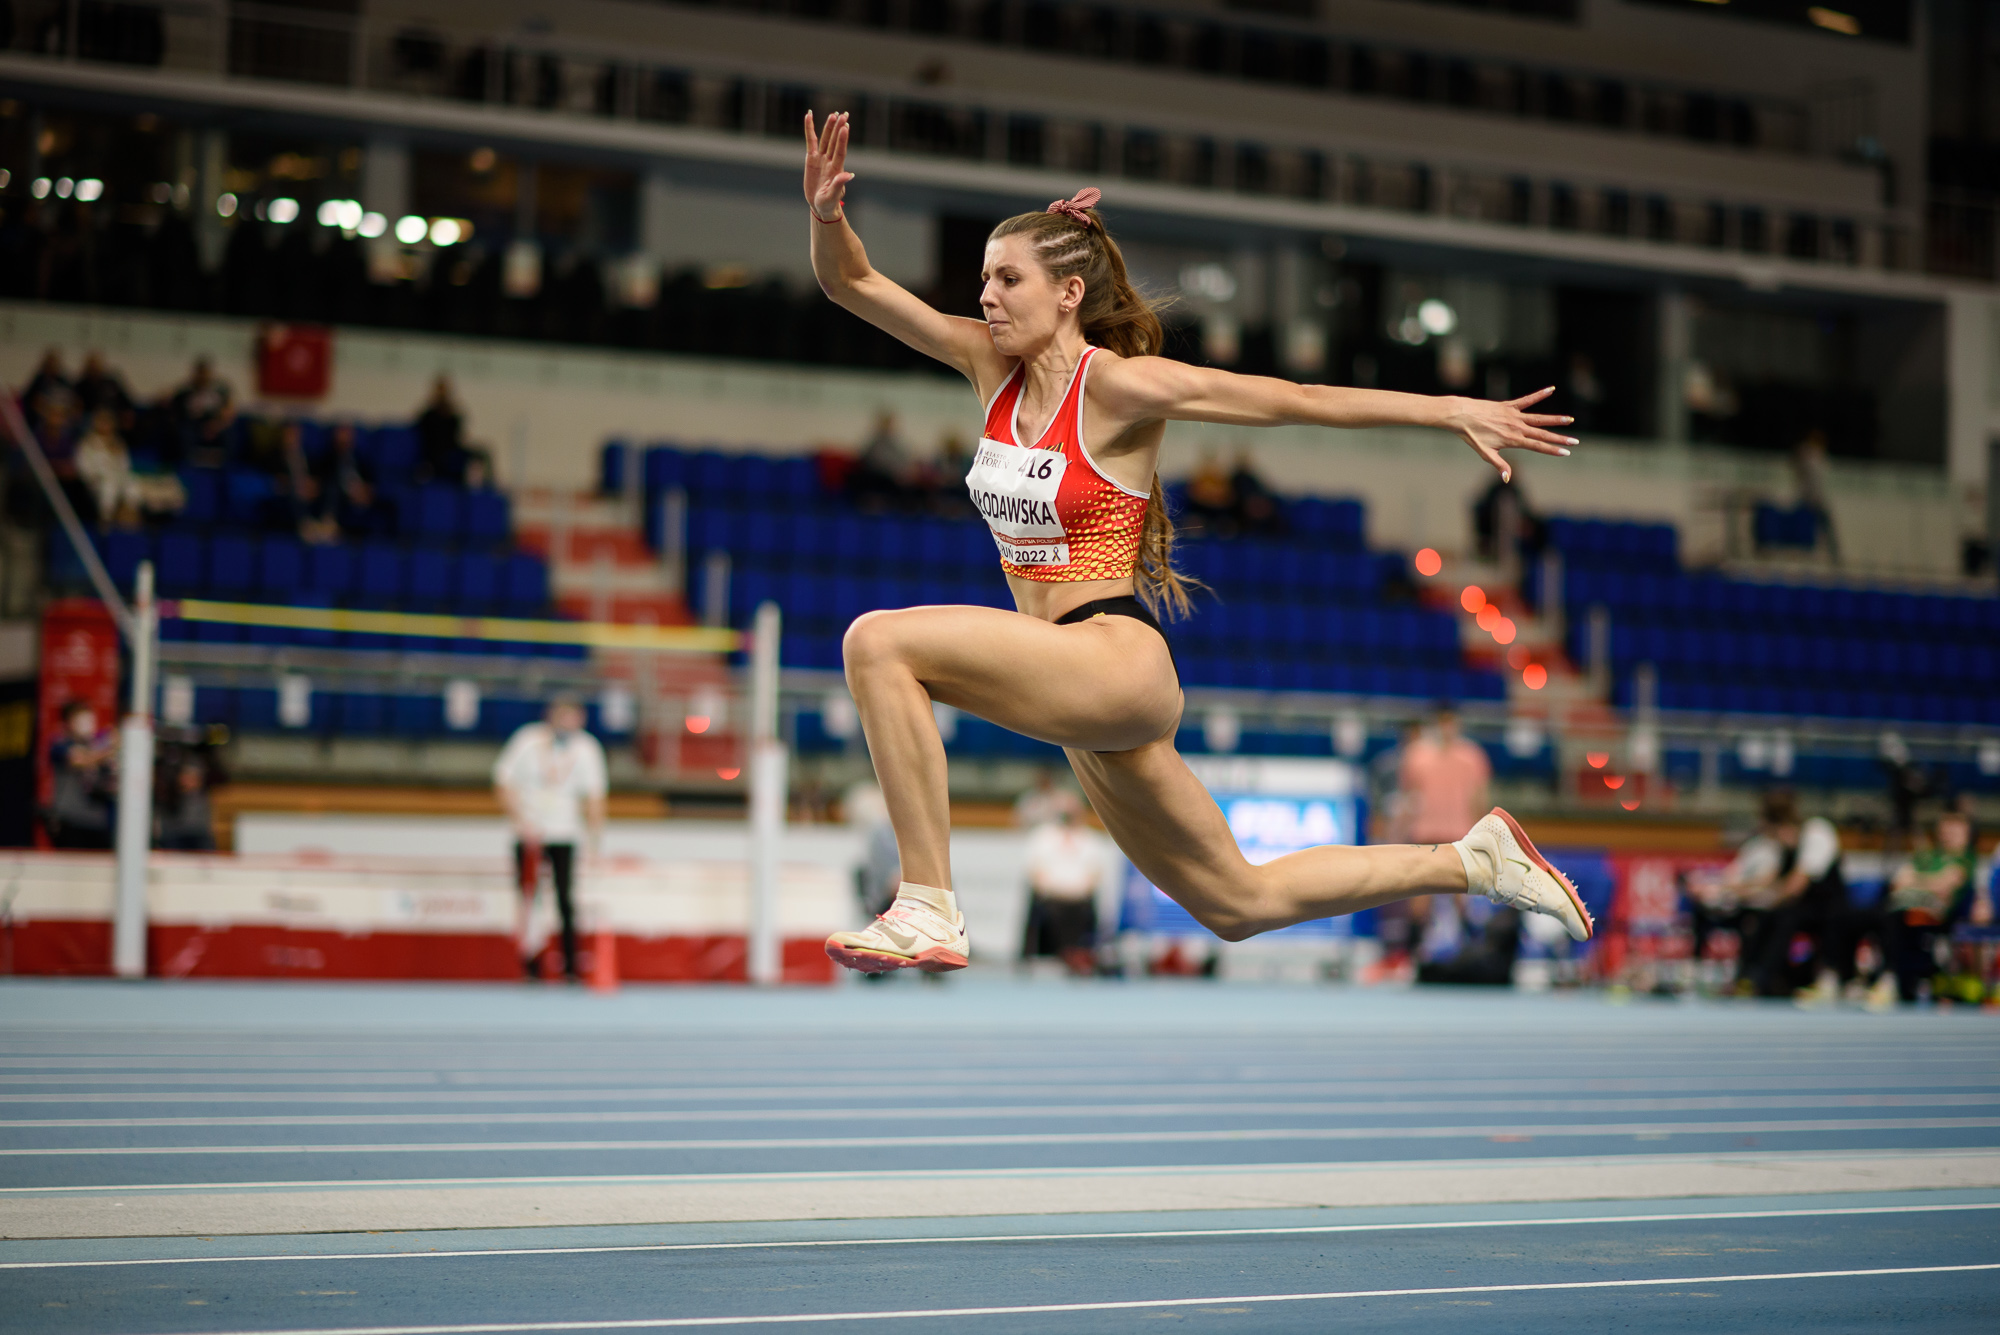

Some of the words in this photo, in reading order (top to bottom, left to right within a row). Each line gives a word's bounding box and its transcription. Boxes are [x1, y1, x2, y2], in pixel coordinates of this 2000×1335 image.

[1018, 456, 1054, 479] 416
[997, 541, 1014, 561] RUŃ
[1015, 550, 1047, 562] 2022
